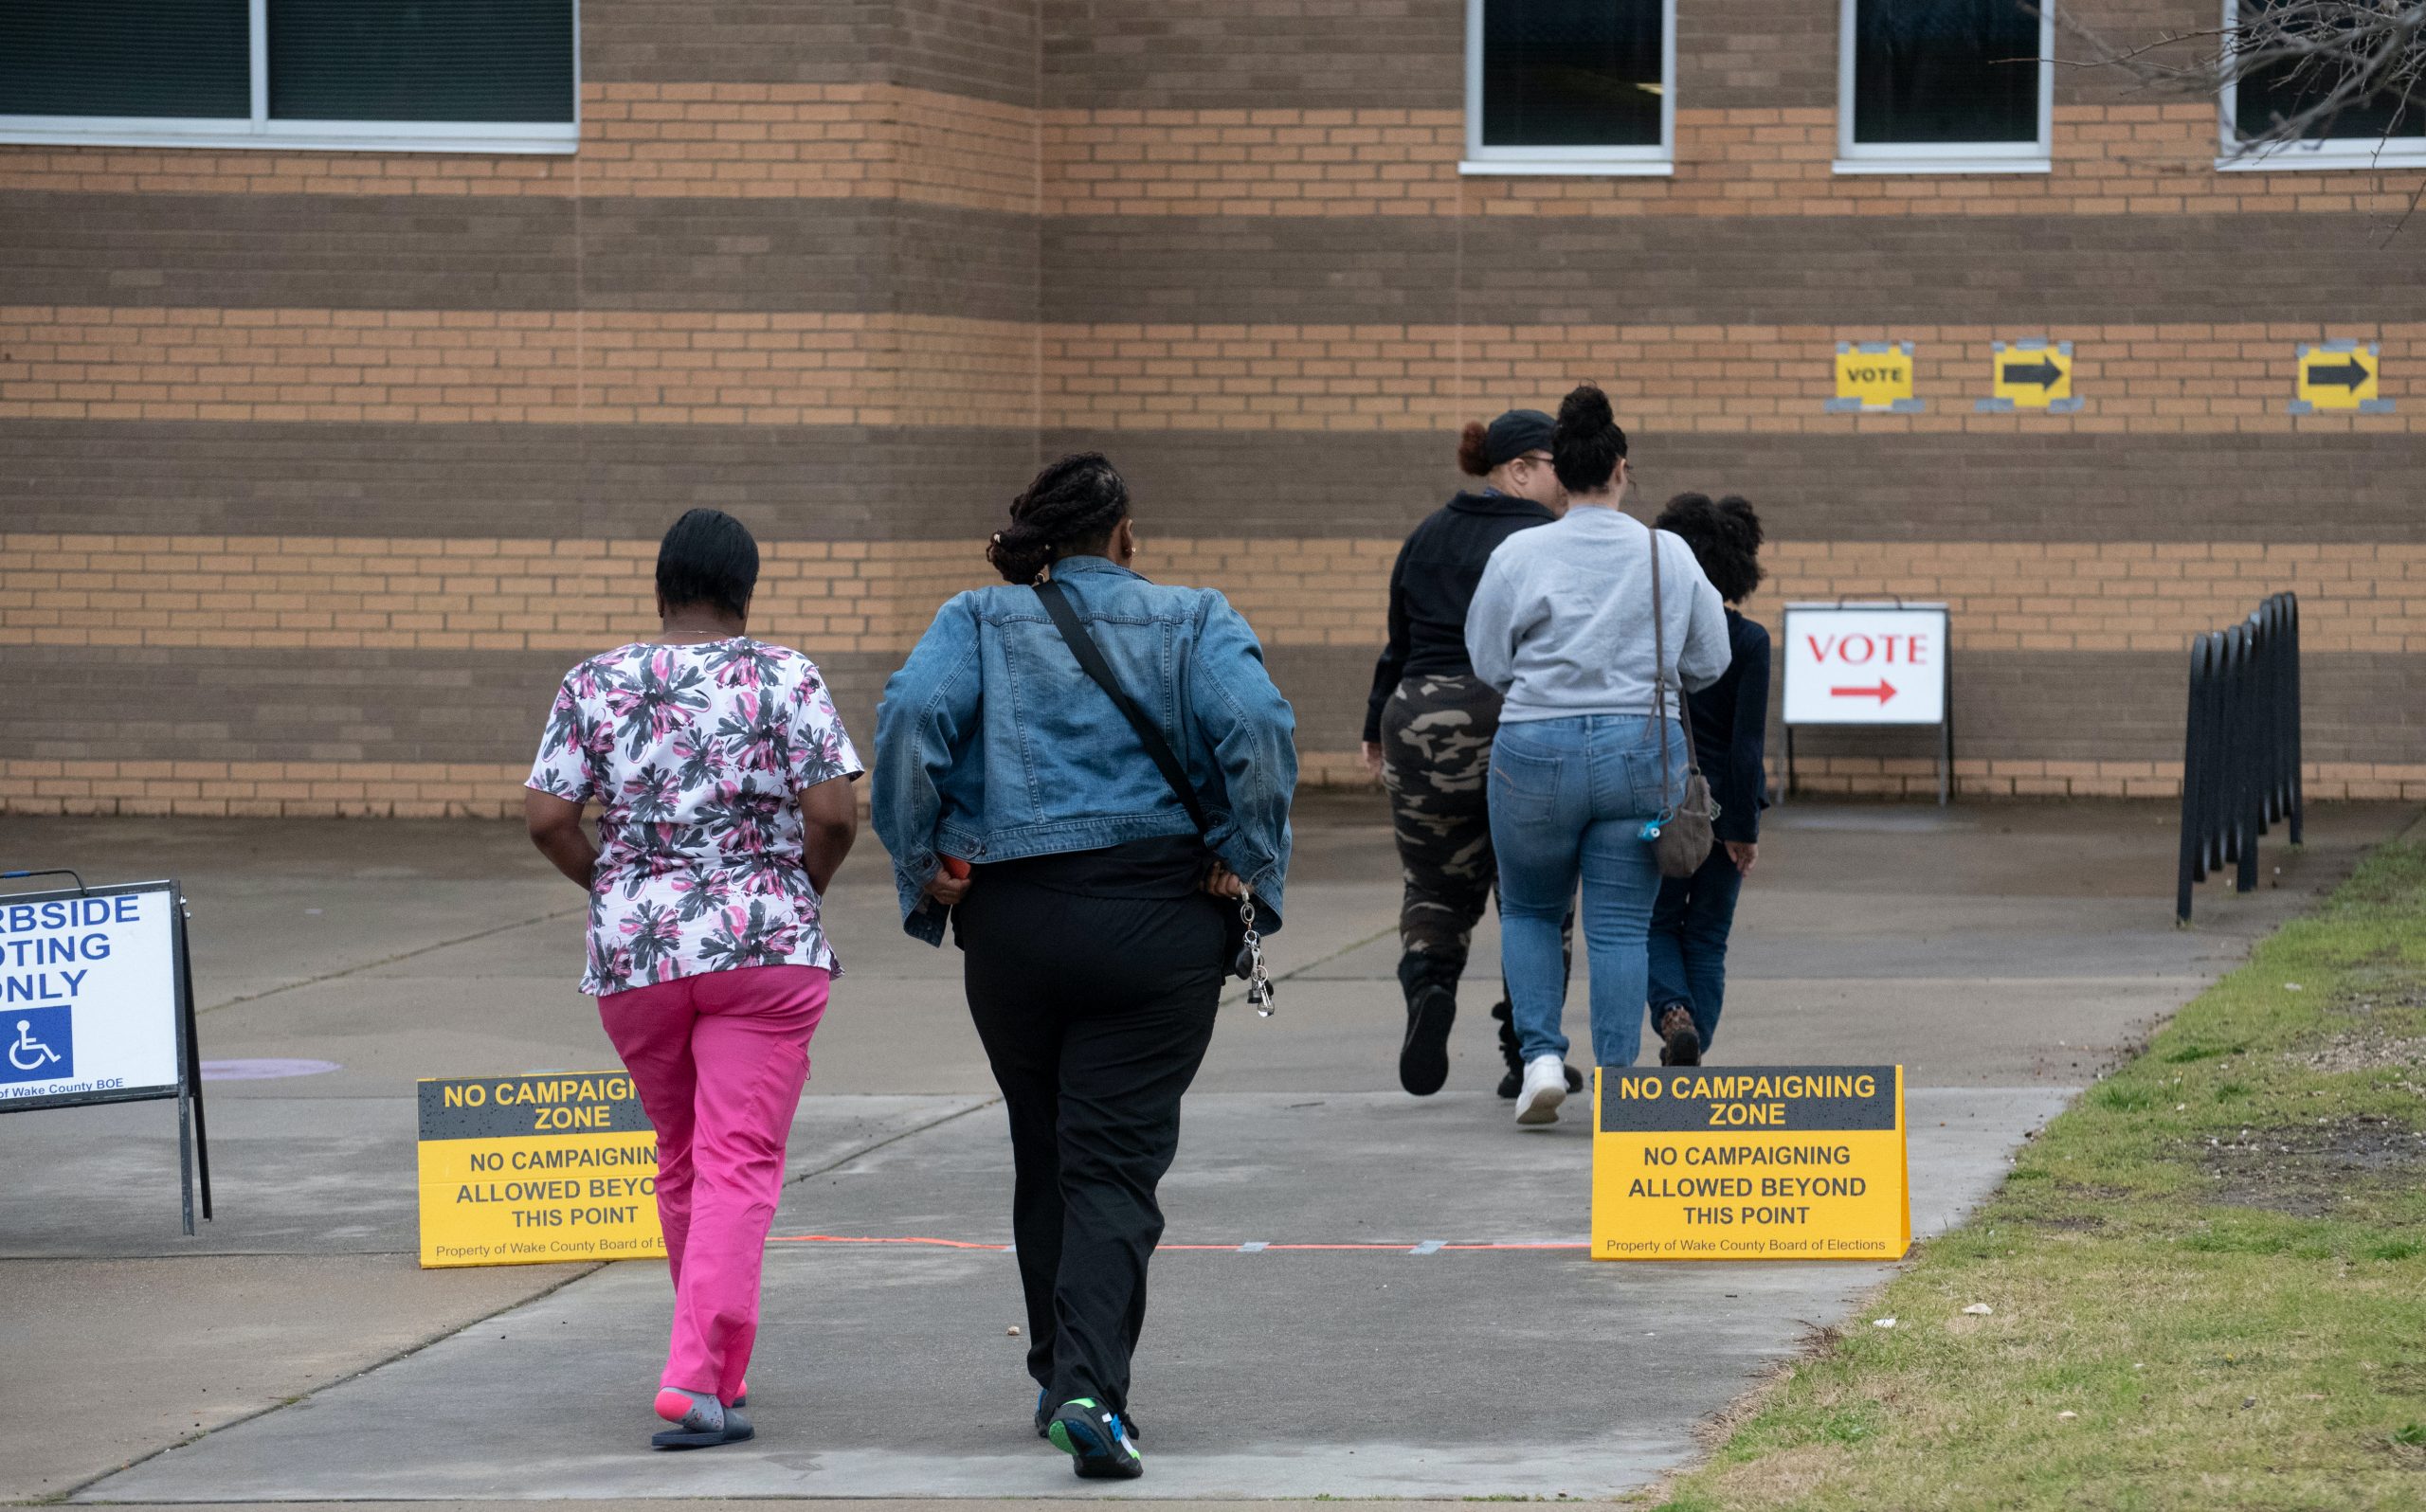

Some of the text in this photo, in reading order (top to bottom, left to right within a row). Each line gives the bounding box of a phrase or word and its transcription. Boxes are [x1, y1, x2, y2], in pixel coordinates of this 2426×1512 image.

[1847, 367, 1903, 384] VOTE
[1806, 633, 1928, 665] VOTE
[0, 895, 139, 933] BSIDE
[0, 933, 110, 966] TING
[0, 969, 88, 1002] NLY
[12, 1087, 45, 1097] Wake
[48, 1082, 93, 1093] County
[97, 1077, 124, 1089] BOE
[444, 1085, 486, 1107] NO
[1621, 1075, 1875, 1100] NO CAMPAIGNING
[534, 1106, 610, 1129] ZONE
[1710, 1103, 1785, 1125] ZONE
[471, 1153, 503, 1171] NO
[1645, 1146, 1850, 1165] NO CAMPAIGNING
[457, 1180, 580, 1203] ALLOWED
[1629, 1178, 1866, 1197] ALLOWED BEYOND
[512, 1206, 638, 1227] THIS POINT
[1683, 1207, 1810, 1224] THIS POINT
[437, 1245, 490, 1258] Property
[495, 1243, 506, 1254] of
[511, 1243, 546, 1253] Wake
[551, 1241, 595, 1252] County
[600, 1238, 637, 1250] Board
[642, 1237, 653, 1248] of
[1607, 1239, 1885, 1253] Property of Wake County Board of Elections
